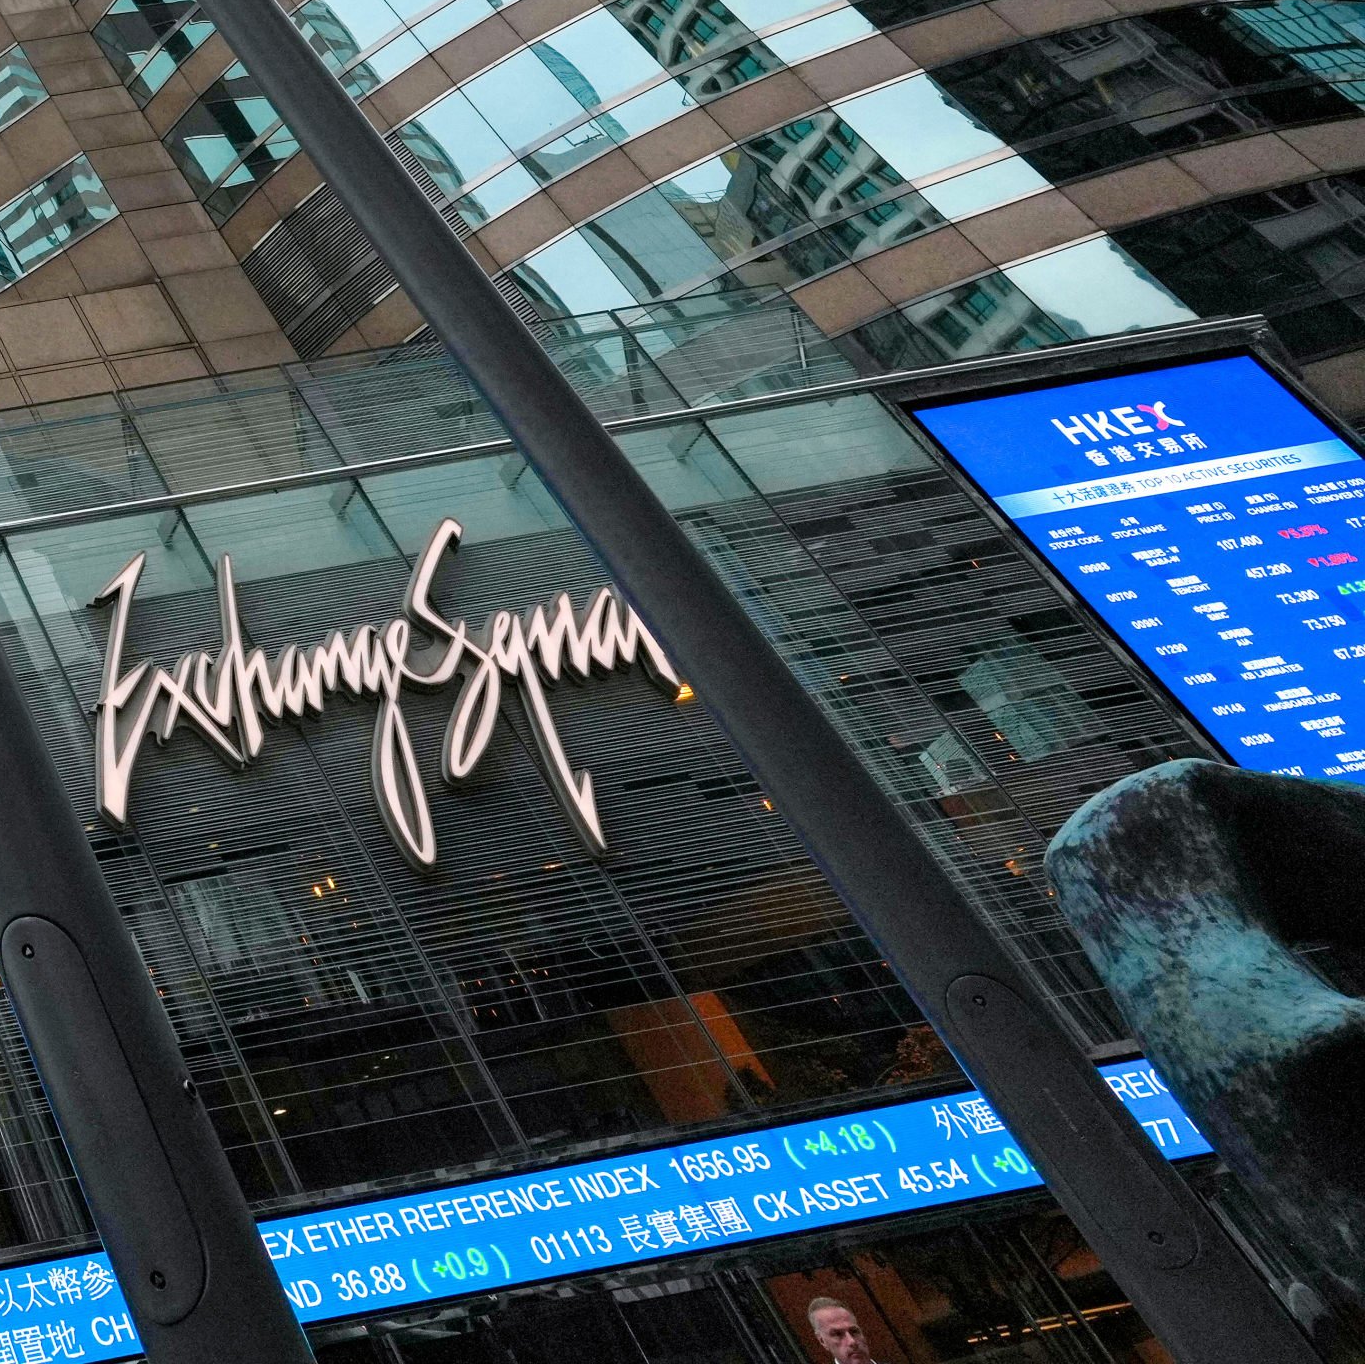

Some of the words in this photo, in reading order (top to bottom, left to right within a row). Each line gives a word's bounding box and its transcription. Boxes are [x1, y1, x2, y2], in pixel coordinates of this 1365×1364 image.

[1051, 401, 1185, 445] HKEX
[1085, 433, 1207, 466] 香港交易所
[1137, 476, 1163, 490] TOP
[1165, 474, 1182, 485] 10
[1183, 464, 1228, 483] ACTIVE
[1228, 453, 1302, 474] SECURITIES
[1247, 504, 1284, 515] CHANGE
[1197, 514, 1224, 523] PRICE
[1112, 529, 1141, 539] STOCK
[1139, 524, 1166, 534] NAME
[1049, 540, 1079, 549] STOCK
[1078, 535, 1103, 545] CODE
[1217, 535, 1263, 550] 107.400
[1246, 563, 1292, 578] 457.200
[1106, 591, 1137, 602] 00700
[1277, 590, 1319, 604] 73.300
[1302, 615, 1346, 630] 73.750
[91, 550, 459, 867] Exchange
[302, 1212, 401, 1252] ETHER
[399, 1181, 571, 1234] REFERENCE
[568, 1164, 660, 1204] INDEX
[669, 1143, 771, 1184] 1656.95
[931, 1097, 1006, 1141] 外匯
[331, 1262, 407, 1302] 36.88
[530, 1223, 613, 1265] 01113
[619, 1197, 753, 1254] 長實集團
[753, 1190, 802, 1222] CK
[803, 1173, 890, 1215] ASSET
[898, 1158, 970, 1195] 45.54
